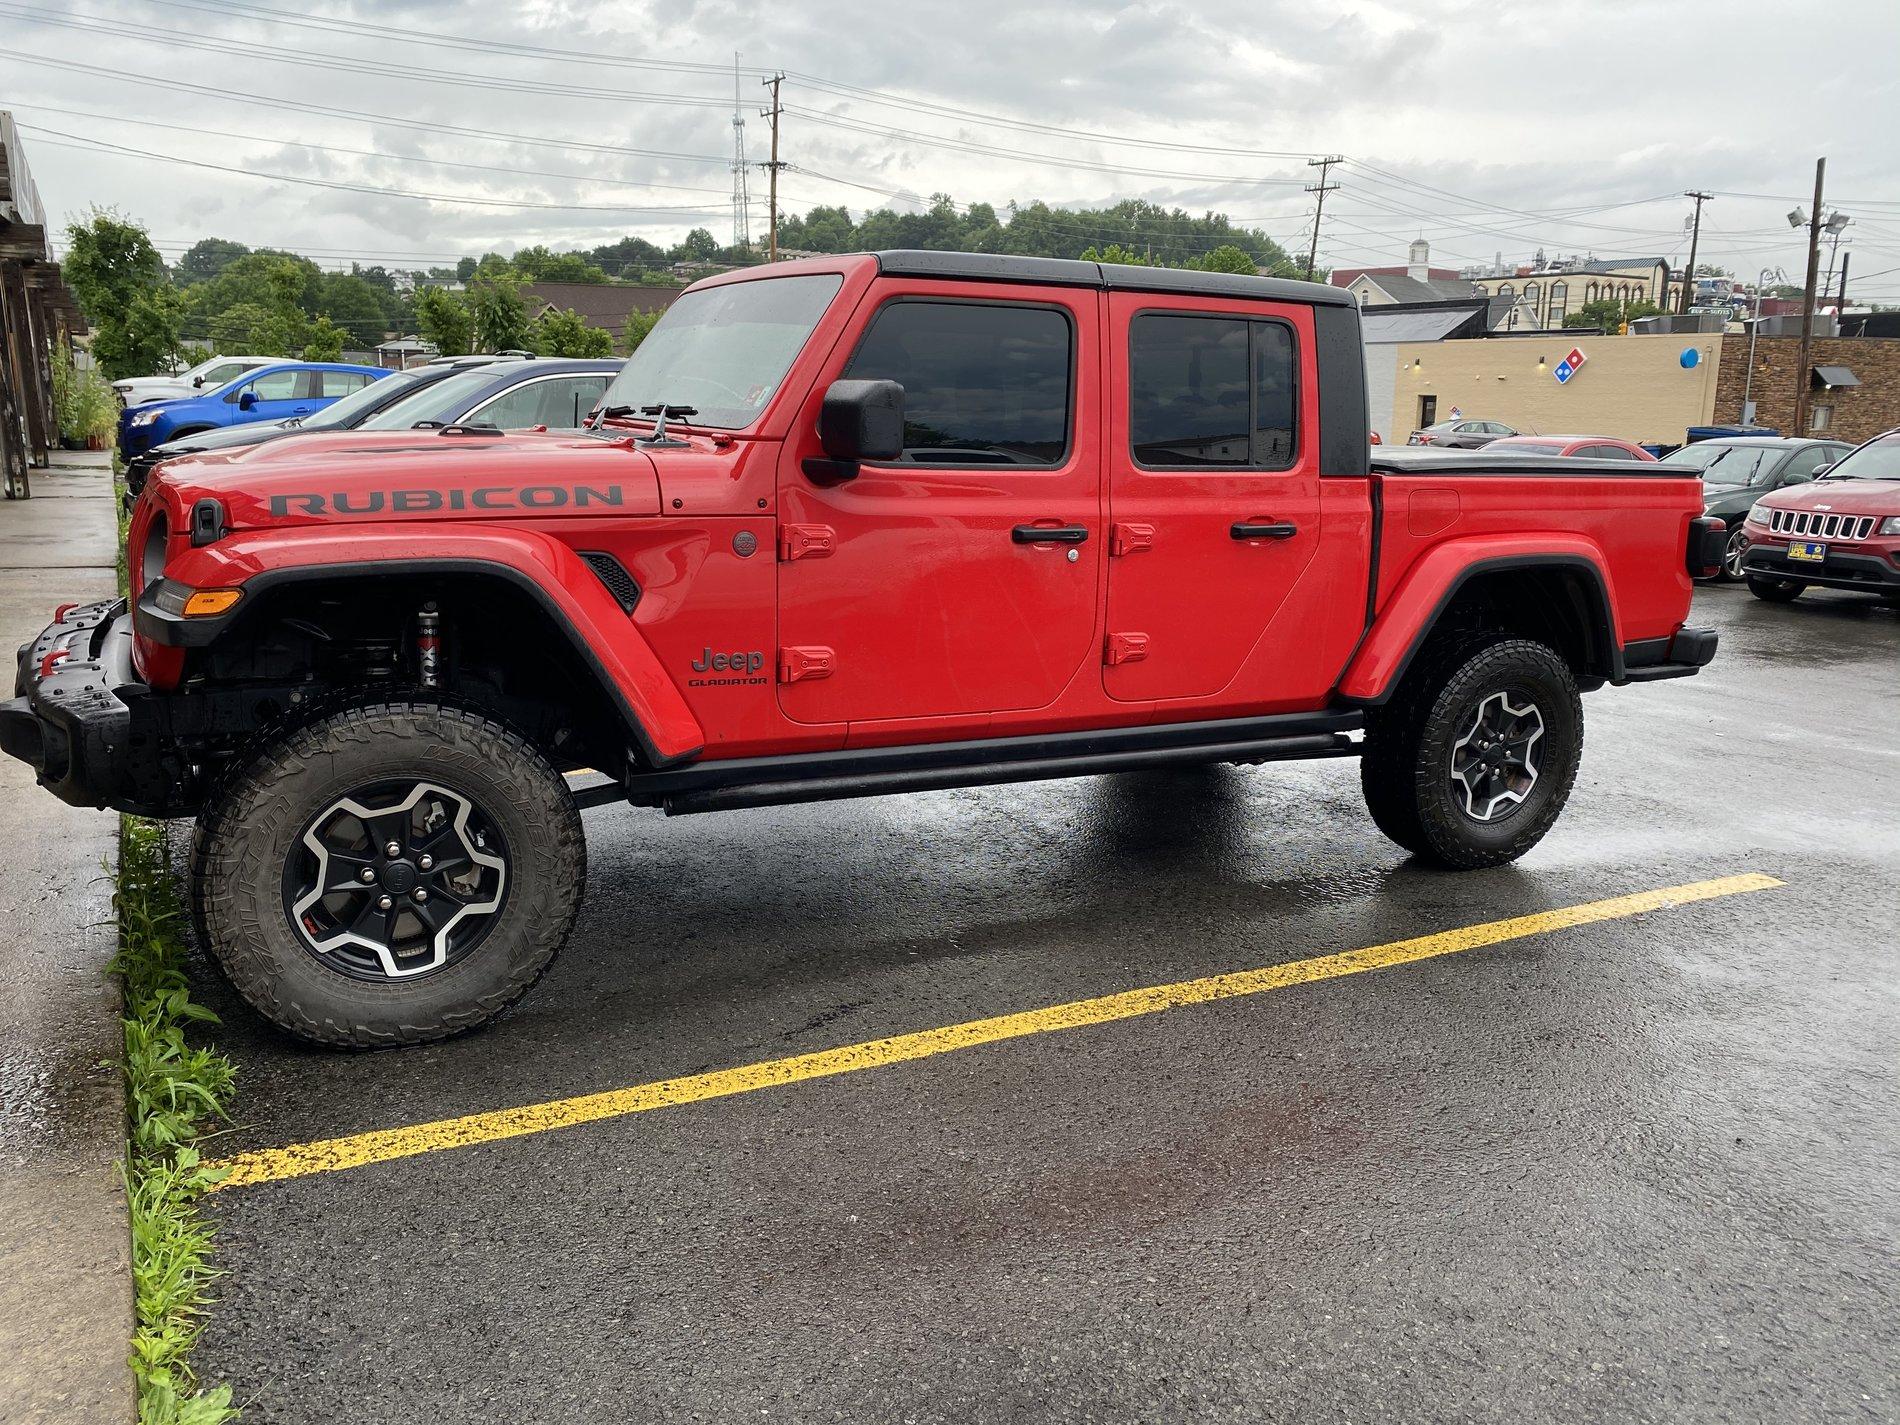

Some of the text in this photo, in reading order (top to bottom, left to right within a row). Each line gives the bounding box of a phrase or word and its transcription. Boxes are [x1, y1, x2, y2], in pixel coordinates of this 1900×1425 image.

[270, 485, 624, 517] RUBICON
[418, 645, 439, 687] FOX
[691, 646, 765, 674] Jeep
[687, 677, 768, 688] GLADIATOR
